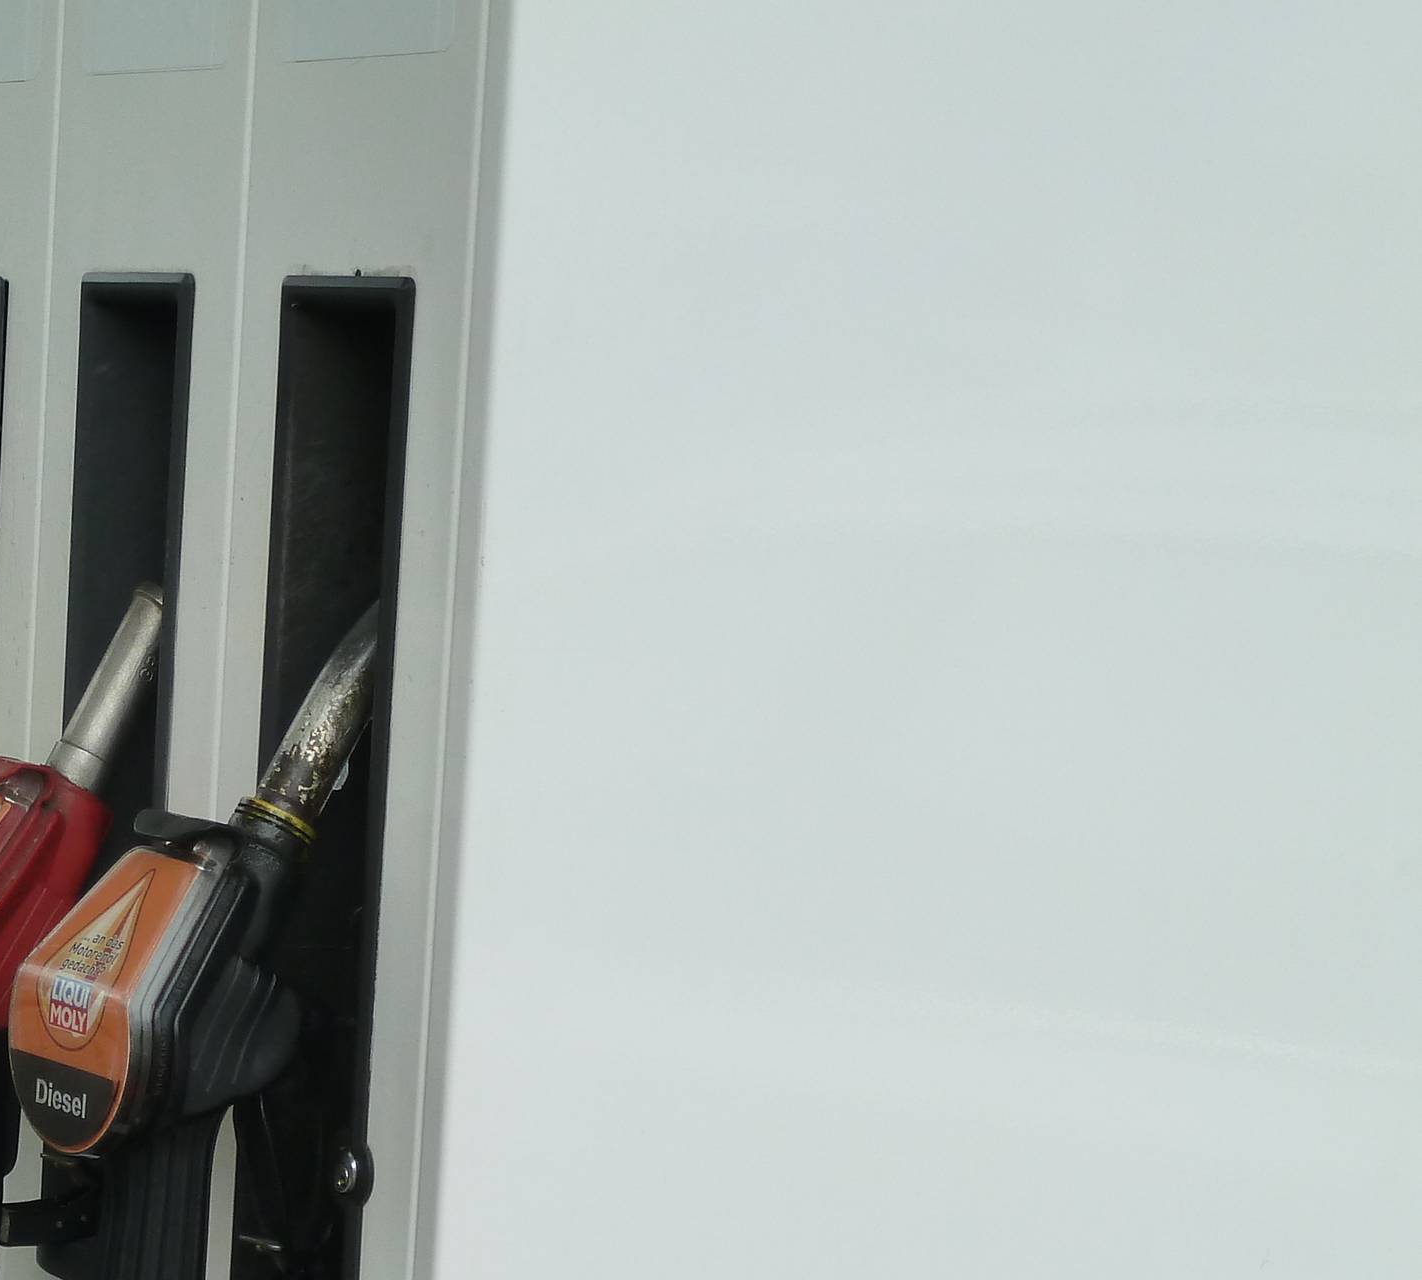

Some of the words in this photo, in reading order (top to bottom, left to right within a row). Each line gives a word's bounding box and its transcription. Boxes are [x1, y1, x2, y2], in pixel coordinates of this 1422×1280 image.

[51, 978, 91, 1008] LIQUI
[49, 1002, 87, 1033] MOLY
[35, 1077, 87, 1119] Diesel
